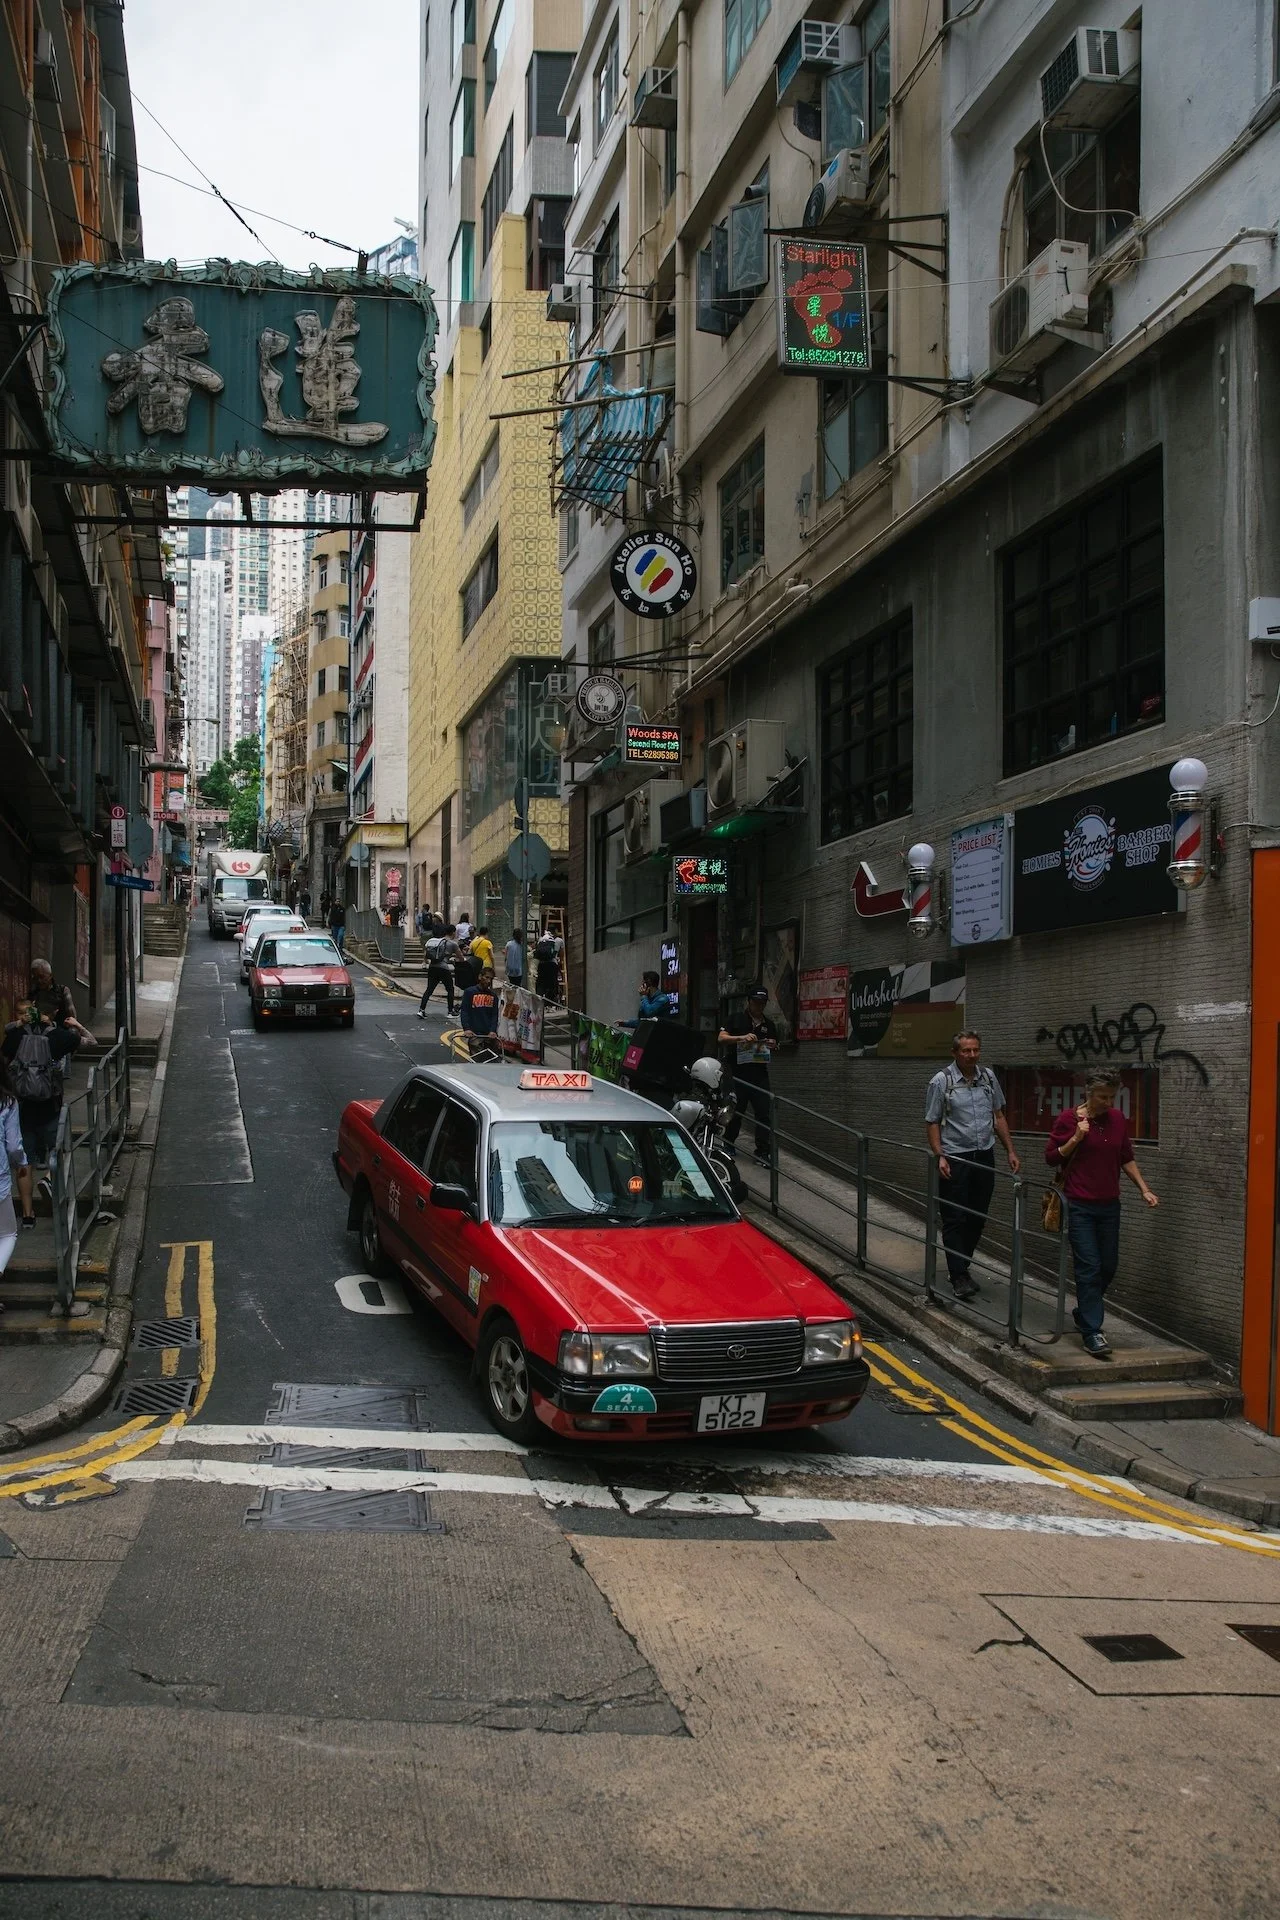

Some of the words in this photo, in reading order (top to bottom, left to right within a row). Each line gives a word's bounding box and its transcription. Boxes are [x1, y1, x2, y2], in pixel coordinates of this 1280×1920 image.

[786, 245, 858, 269] Starlight
[833, 312, 860, 329] 1/F
[614, 534, 650, 574] Atelier
[655, 532, 681, 553] Sun
[680, 554, 693, 576] Ho
[628, 728, 661, 739] Woods
[662, 731, 679, 741] SPA
[628, 739, 651, 748] Second
[651, 740, 666, 749] Floor
[153, 812, 176, 820] GLOBE
[113, 822, 124, 844] 上環
[958, 838, 979, 852] PRICE
[980, 832, 997, 847] LIST
[1117, 823, 1172, 851] BARBER
[1066, 834, 1112, 872] Homies
[1125, 845, 1159, 867] SHOP
[1022, 851, 1061, 875] HOMIES
[851, 976, 900, 1010] Unlashed
[532, 1073, 587, 1087] TAXI
[630, 1180, 643, 1190] TAXI
[614, 1384, 640, 1393] TAXI
[607, 1404, 644, 1412] SEATS
[620, 1393, 632, 1404] 4
[718, 1395, 747, 1413] KT
[705, 1410, 756, 1430] 5122
